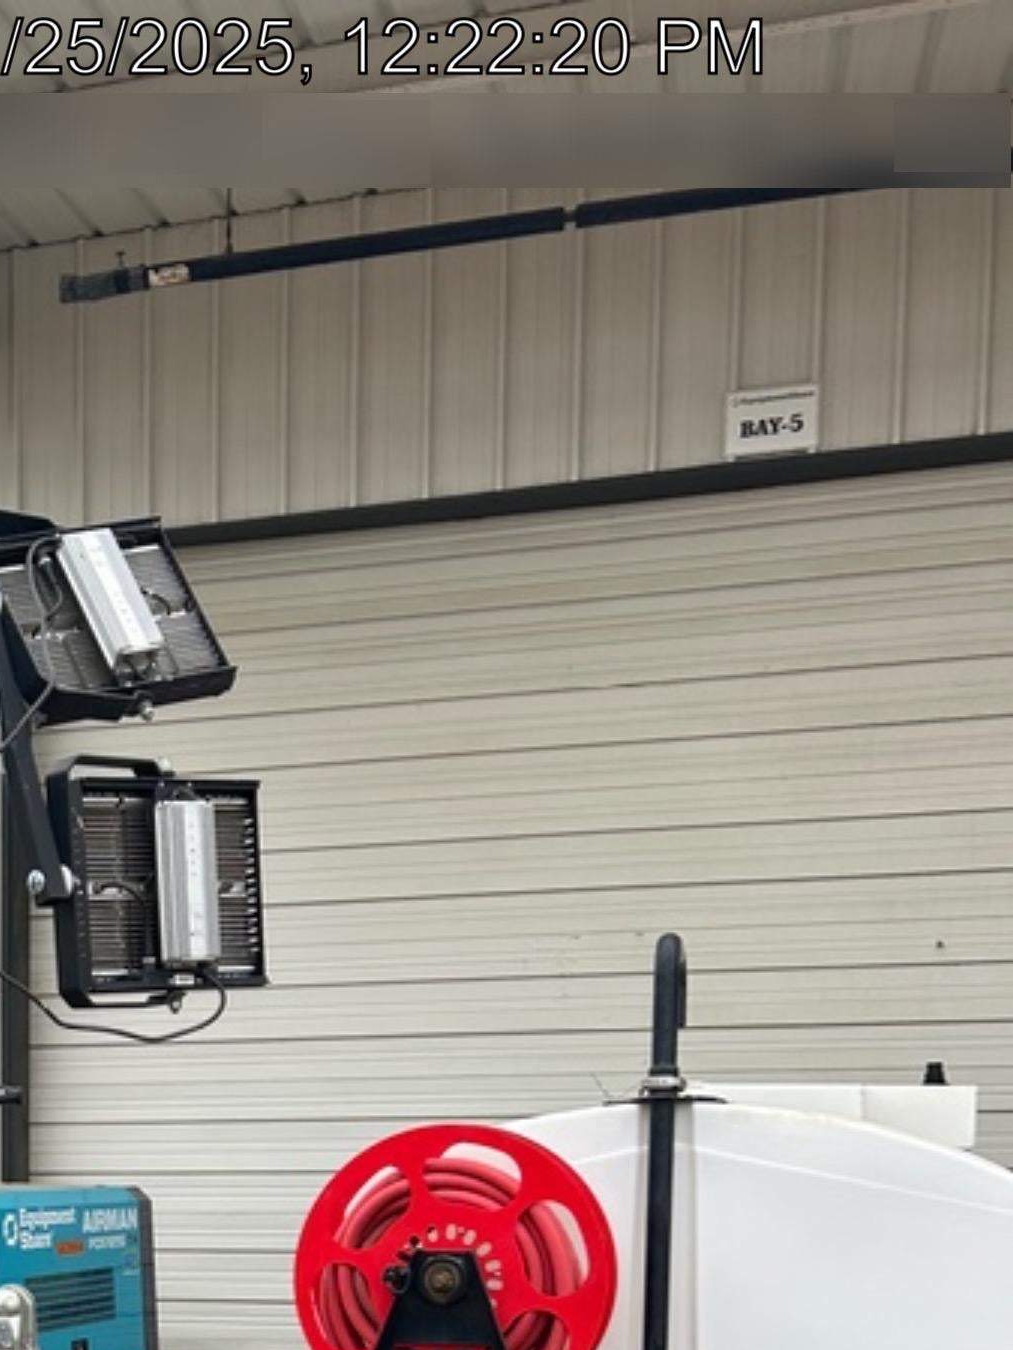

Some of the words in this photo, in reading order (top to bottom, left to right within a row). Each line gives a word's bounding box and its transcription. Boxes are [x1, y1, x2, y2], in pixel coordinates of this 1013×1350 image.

[739, 412, 805, 439] BAY-5
[19, 1207, 76, 1230] Equipment
[82, 1206, 139, 1234] AIRMAN
[19, 1231, 52, 1250] Share
